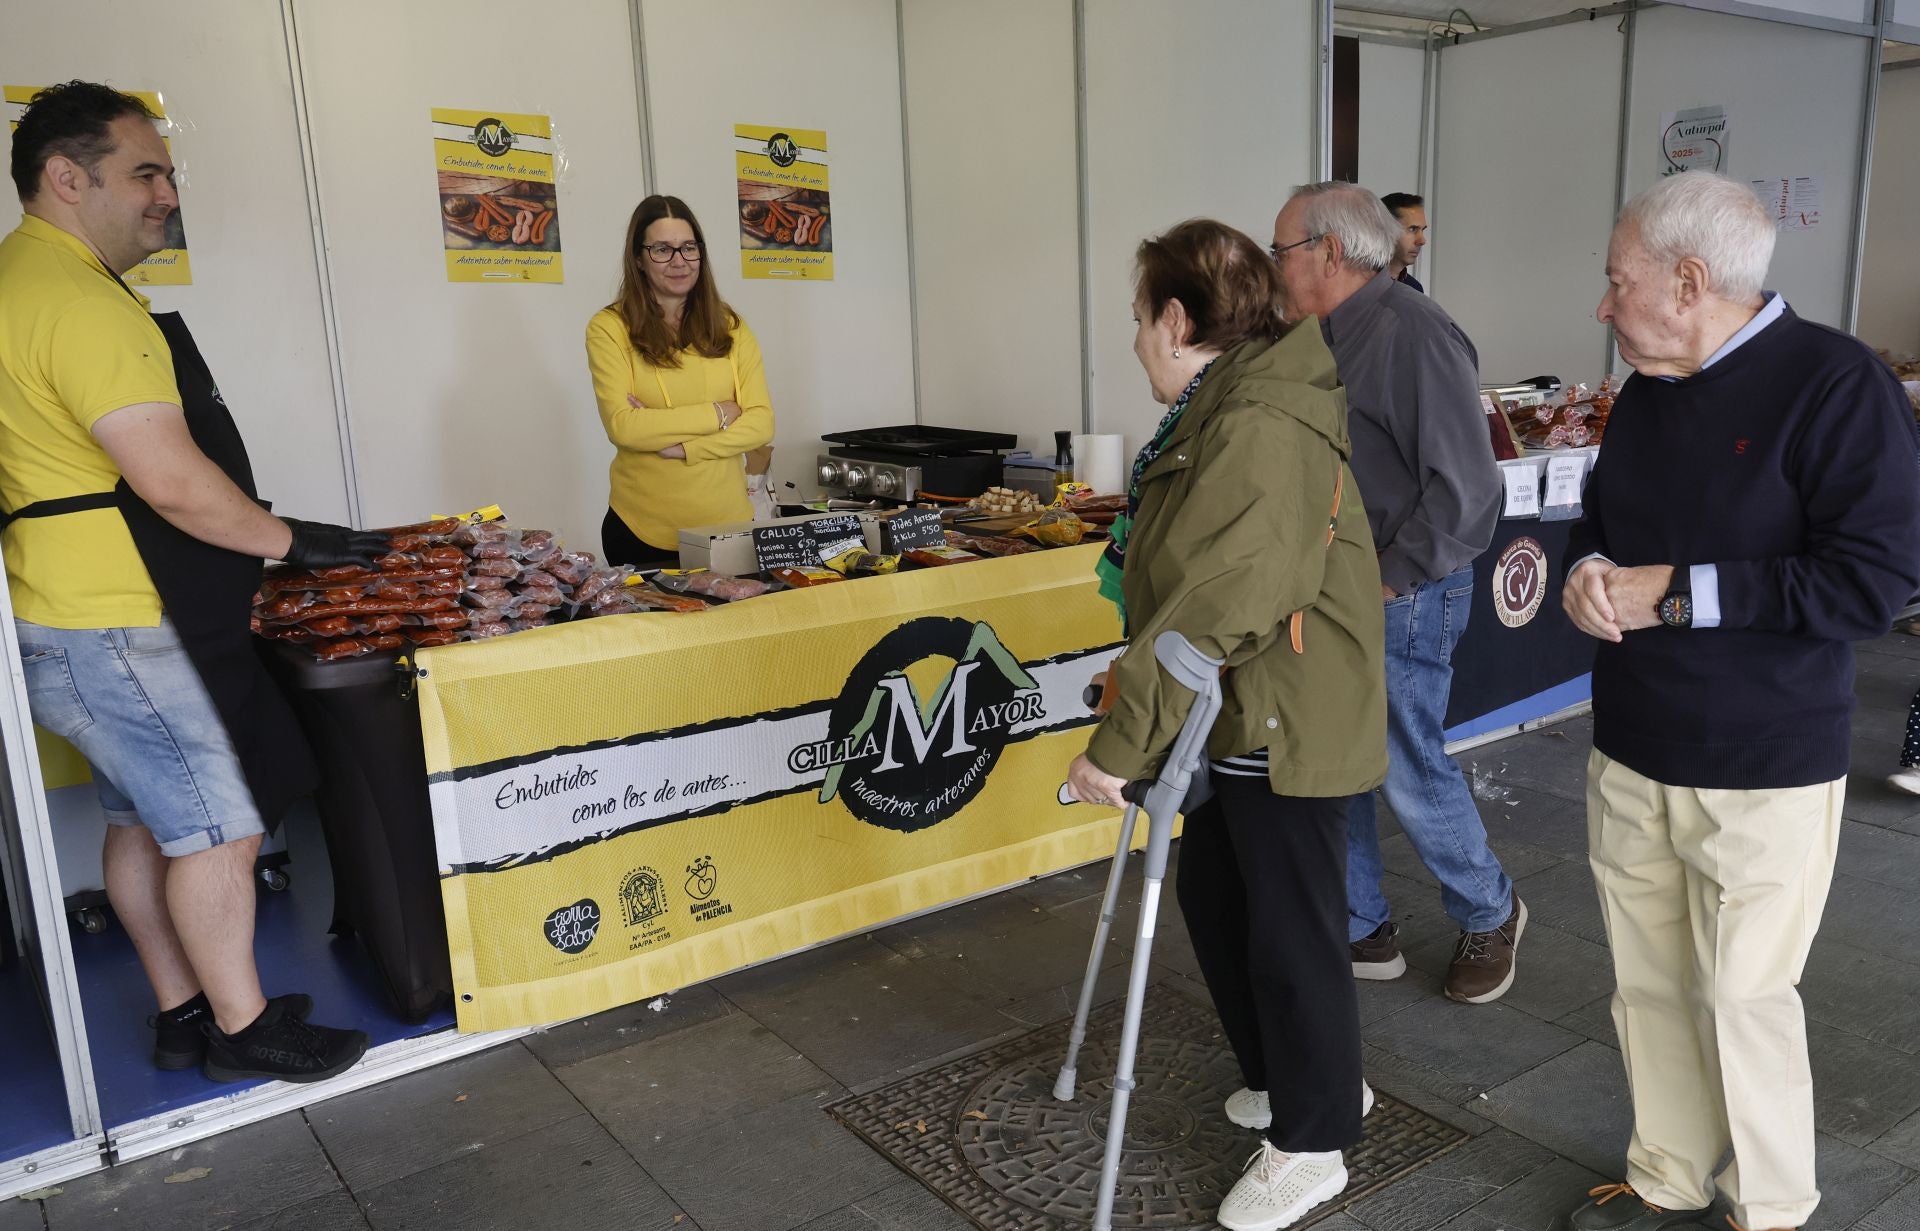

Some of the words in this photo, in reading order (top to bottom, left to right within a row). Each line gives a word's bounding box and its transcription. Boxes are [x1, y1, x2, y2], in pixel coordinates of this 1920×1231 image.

[1671, 149, 1693, 158] 2025
[443, 155, 484, 169] Embutidos
[486, 163, 504, 171] como
[507, 163, 516, 174] los
[518, 164, 526, 174] de
[529, 168, 547, 177] antes
[494, 256, 513, 265] sabor
[514, 256, 553, 266] tradicional
[760, 526, 805, 539] CALLOS
[921, 524, 940, 535] 5'50
[798, 538, 816, 549] 6'50
[760, 563, 766, 571] 3
[790, 732, 882, 773] CILLA
[871, 661, 1047, 773] MAYOR
[495, 764, 599, 810] Embutidos
[850, 776, 920, 818] maestros
[925, 747, 992, 815] artesanos
[572, 797, 617, 824] como
[623, 784, 648, 810] los
[653, 779, 676, 803] de
[682, 774, 747, 798] antes...
[690, 899, 721, 915] Alimentos
[702, 904, 733, 921] PALENCIA
[545, 905, 600, 928] tierra
[550, 925, 569, 938] de
[555, 921, 600, 951] sabor
[641, 926, 666, 939] Artesano
[629, 940, 653, 951] EAA/PA
[1091, 1056, 1199, 1075] PAENCIA
